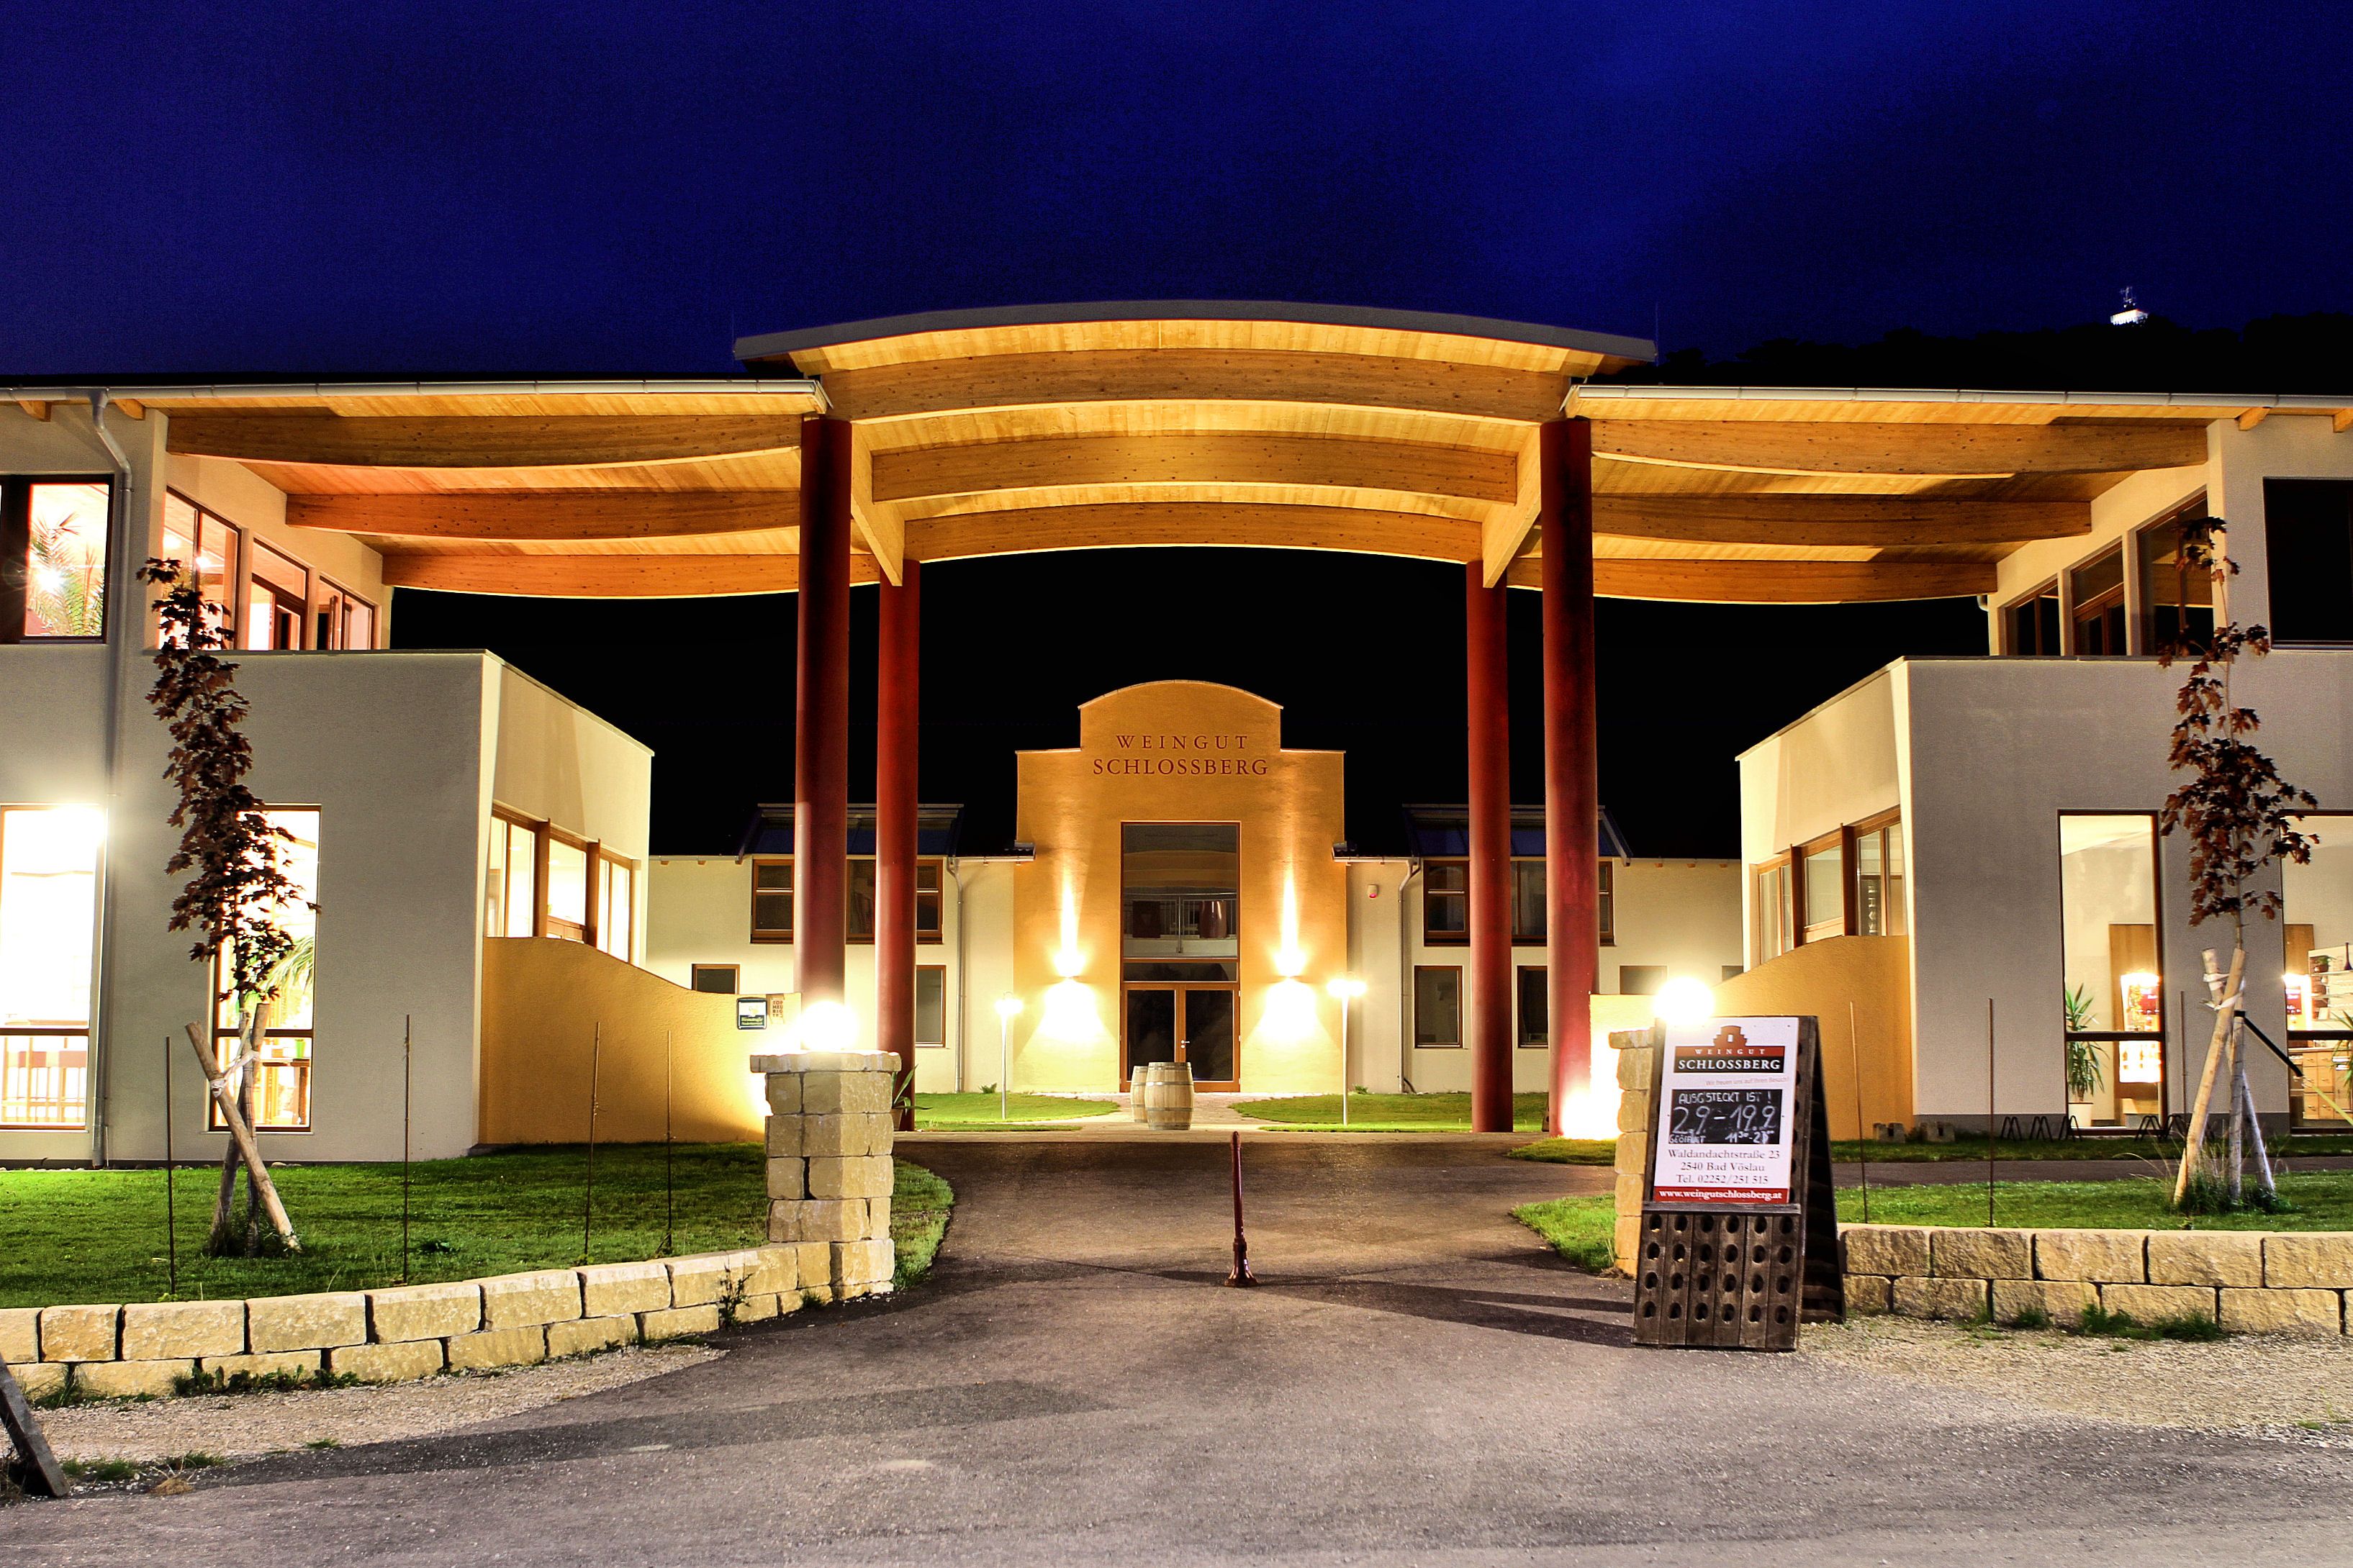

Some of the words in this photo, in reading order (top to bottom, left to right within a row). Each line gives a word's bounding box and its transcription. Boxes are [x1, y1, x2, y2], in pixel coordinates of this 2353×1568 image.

[1116, 735, 1248, 750] WEINGUT
[1093, 758, 1269, 776] SCHLOSSBERG
[1678, 1059, 1781, 1070] SCHLOSSBERG
[1668, 1149, 1766, 1159] Waldandachtstraße
[1769, 1151, 1780, 1159] 23
[1681, 1161, 1703, 1171] 2540
[1707, 1162, 1726, 1172] Bad
[1730, 1162, 1765, 1172] Vöslau
[1676, 1174, 1694, 1183] Tel.
[1752, 1175, 1769, 1184] 515
[1658, 1189, 1782, 1200] www.weingutschlossberg.at
